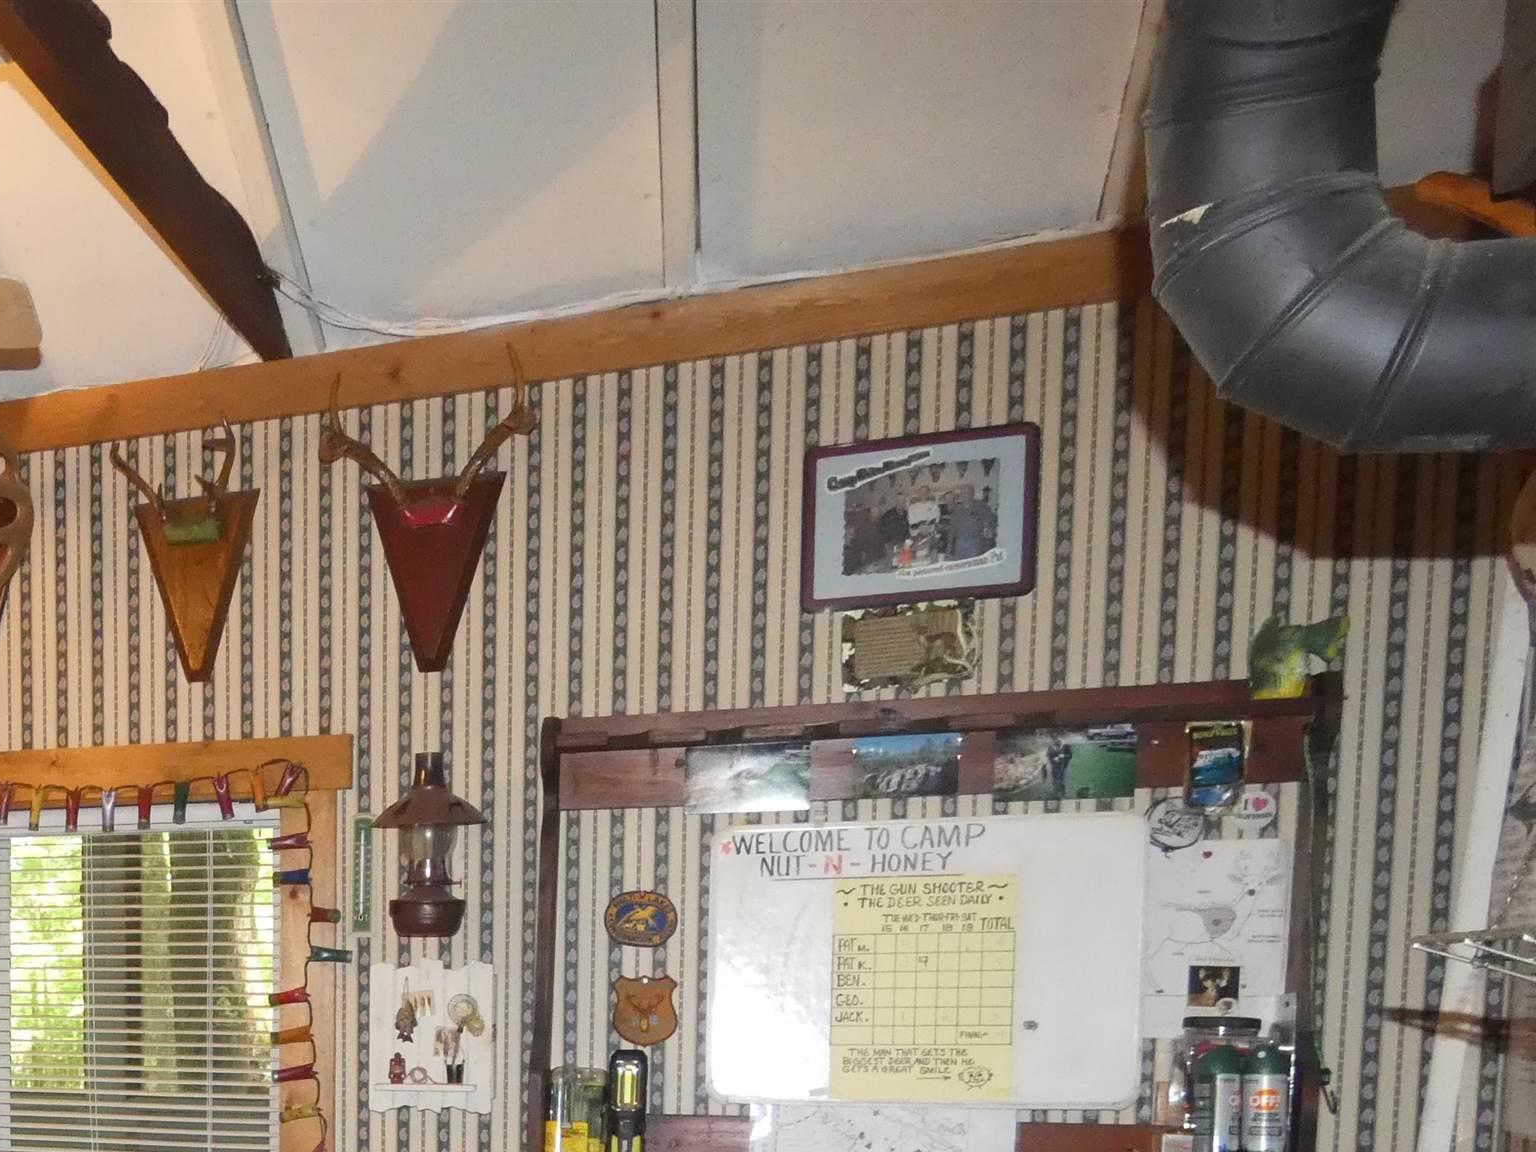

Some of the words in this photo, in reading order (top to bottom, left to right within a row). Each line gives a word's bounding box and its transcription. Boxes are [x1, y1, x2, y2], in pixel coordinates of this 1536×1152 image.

[731, 829, 851, 855] WELCOME
[864, 827, 890, 850] TO
[901, 823, 987, 850] CAMP
[860, 884, 886, 896] THE
[889, 883, 917, 895] GUN
[922, 881, 985, 894] SHOOTER
[857, 897, 885, 908] THE
[887, 896, 922, 908] DEER
[926, 895, 957, 907] SEEN
[959, 894, 992, 905] DAILY
[980, 917, 1013, 930] TOTAL
[838, 938, 857, 952] PAT
[837, 956, 856, 970] PAT
[848, 1048, 870, 1056] THE
[895, 1048, 919, 1056] THAT
